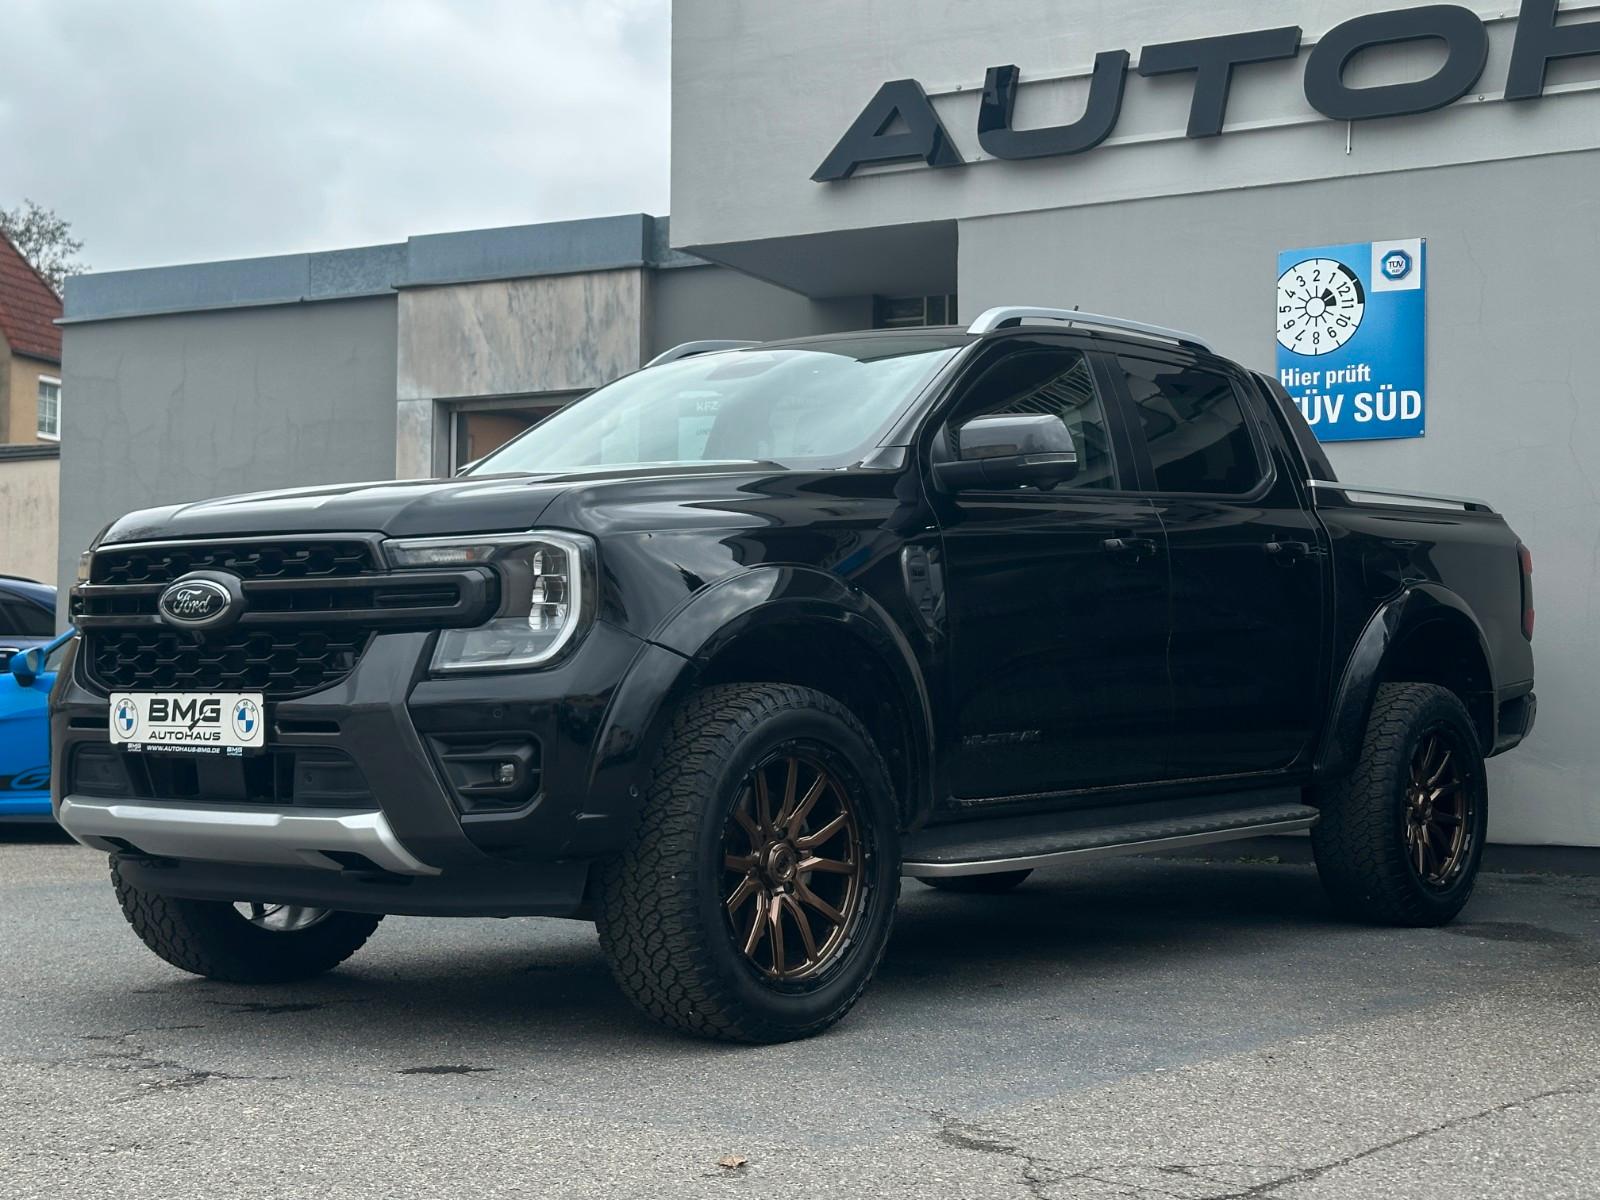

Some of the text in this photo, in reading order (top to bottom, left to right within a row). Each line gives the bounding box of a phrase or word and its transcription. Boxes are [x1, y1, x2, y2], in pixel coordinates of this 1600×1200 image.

[1296, 275, 1306, 287] 3
[1313, 269, 1321, 282] 2
[1329, 272, 1336, 284] 1
[1285, 289, 1296, 298] 4
[1336, 281, 1351, 297] 12
[1279, 305, 1292, 313] 5
[1341, 297, 1355, 309] 11
[1283, 319, 1296, 330] 6
[1335, 313, 1351, 328] 10
[1294, 329, 1306, 341] 7
[1312, 331, 1320, 345] 8
[1327, 326, 1337, 338] 9
[1281, 363, 1371, 389] Hier prüft
[1353, 383, 1422, 422] SÜD
[173, 588, 211, 613] Ford
[148, 698, 221, 724] BMG
[148, 730, 221, 741] AUTOHAUS
[146, 744, 221, 755] WWW.AUTOHAUS-BMG.DE
